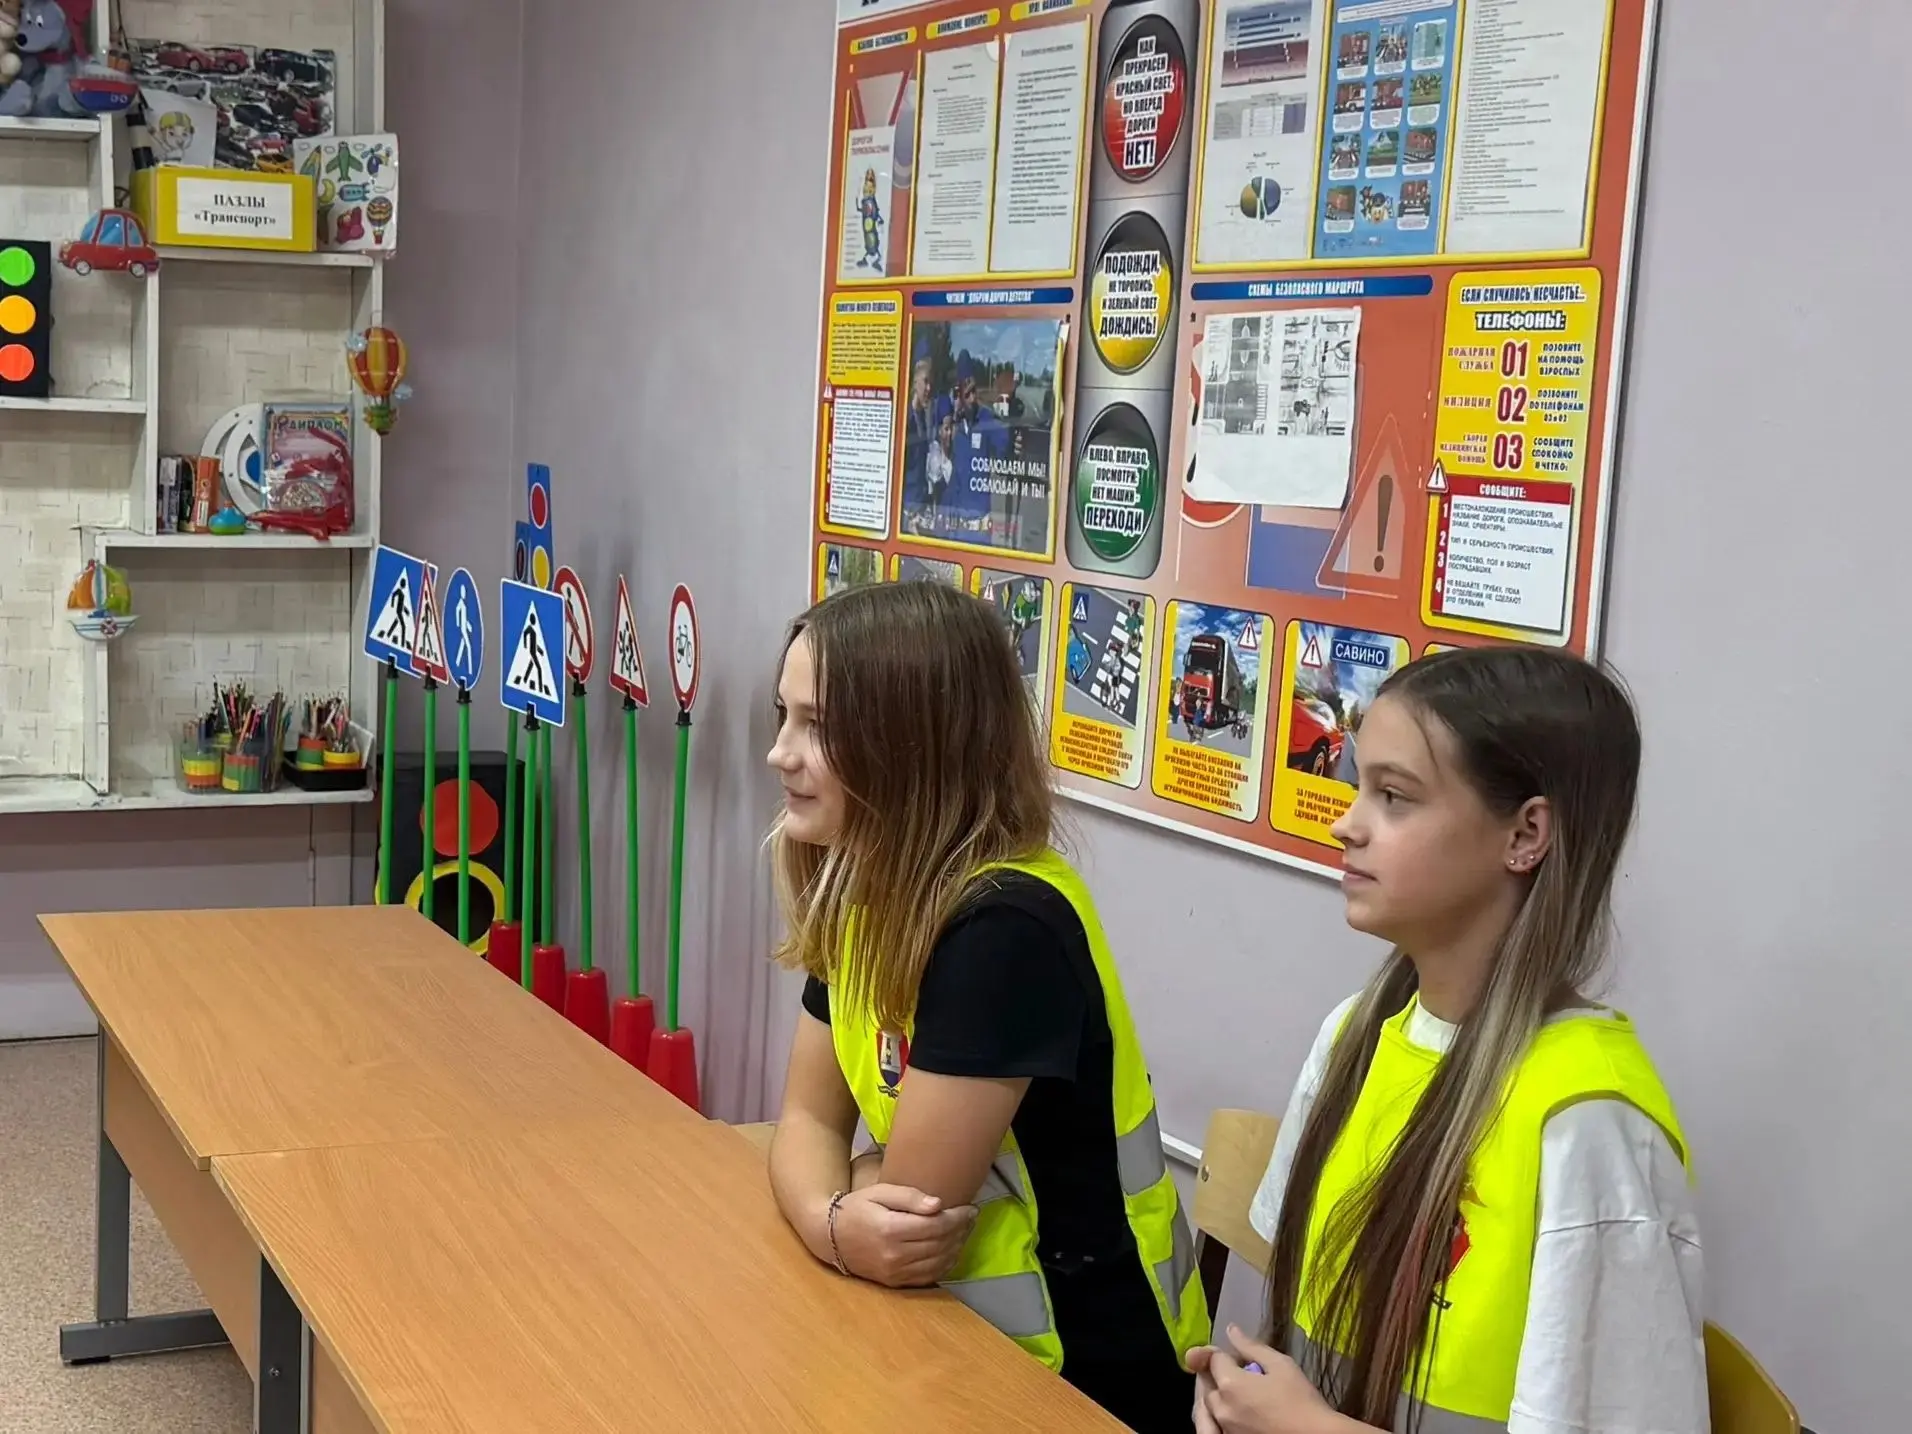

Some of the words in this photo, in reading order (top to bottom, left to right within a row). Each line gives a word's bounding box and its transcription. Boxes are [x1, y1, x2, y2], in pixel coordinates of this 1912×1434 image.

[1140, 39, 1154, 54] КАК
[1125, 56, 1166, 75] ПРЕКРАСЕН
[1116, 78, 1152, 97] КРАСНЫЙ
[1123, 101, 1133, 114] НО
[1134, 96, 1162, 114] ВПЕРЕД
[1127, 117, 1156, 134] ДОРОГИ
[1125, 140, 1155, 166] НЕТ!
[214, 194, 265, 208] ПАЗЛЫ
[194, 210, 276, 227] «Транспорт»
[1105, 254, 1160, 275] ПОДОЖДИ,
[1109, 280, 1117, 292] НЕ
[1118, 279, 1152, 292] ТОРОПИСЬ
[1248, 284, 1273, 297] СХЕМЫ
[1275, 282, 1324, 296] БЕЗОПАСНОГО
[1325, 280, 1365, 295] МАРШРУТА
[1461, 288, 1481, 302] ЕСЛИ
[1484, 287, 1531, 302] СЛУЧИЛОСЬ
[1140, 297, 1157, 309] СВЕТ
[1100, 316, 1156, 337] ДОЖДИСЬ!
[1476, 311, 1565, 330] ТЕЛЕФОНЫ:
[1448, 347, 1495, 357] ПОЖАРНАЯ
[1543, 343, 1581, 352] ПОЗОВИТЕ
[1459, 361, 1494, 371] СЛУЖБА
[1502, 341, 1529, 377] 01
[1537, 356, 1548, 364] НА
[1549, 355, 1584, 365] ПОМОЩЬ
[1539, 367, 1581, 376] ВЗРОСЛЫХ
[1537, 389, 1579, 399] ПОЗВОНИТЕ
[1444, 397, 1491, 409] МИЛИЦИЯ
[1498, 387, 1528, 423] 02
[1529, 401, 1539, 410] ПО
[1540, 401, 1584, 411] ТЕЛЕФОНАМ
[1533, 437, 1574, 448] СООБЩИТЕ
[1493, 433, 1524, 469] 03
[1532, 449, 1574, 459] СПОКОЙНО
[971, 457, 1025, 476] СОБЛЮДАЕМ
[1542, 461, 1568, 472] ЧЕТКО:
[970, 477, 1019, 495] СОБЛЮДАЙ
[1021, 482, 1028, 497] И
[1092, 486, 1105, 500] НЕТ
[1479, 484, 1527, 498] СООБЩИТЕ:
[1443, 503, 1448, 518] 1
[1453, 503, 1507, 515] МЕСТОНАХОЖДЕНИЕ
[1086, 506, 1143, 534] ПЕРЕХОДИ
[1453, 512, 1479, 521] НАЗВАНИЕ
[1507, 516, 1563, 529] ОПОЗНАВАТЕЛЬНЫЕ
[1440, 530, 1446, 546] 2
[1451, 536, 1461, 544] ТИП
[1469, 538, 1507, 550] СЕРЬЕЗНОСТЬ
[1438, 552, 1444, 568] 3
[1487, 558, 1498, 566] ПОЛ
[1506, 561, 1531, 571] ВОЗРАСТ
[1435, 577, 1442, 593] 4
[1455, 580, 1480, 590] ВЕШАЙТЕ
[1505, 586, 1520, 595] ПОКА
[1335, 643, 1385, 665] САВИНО
